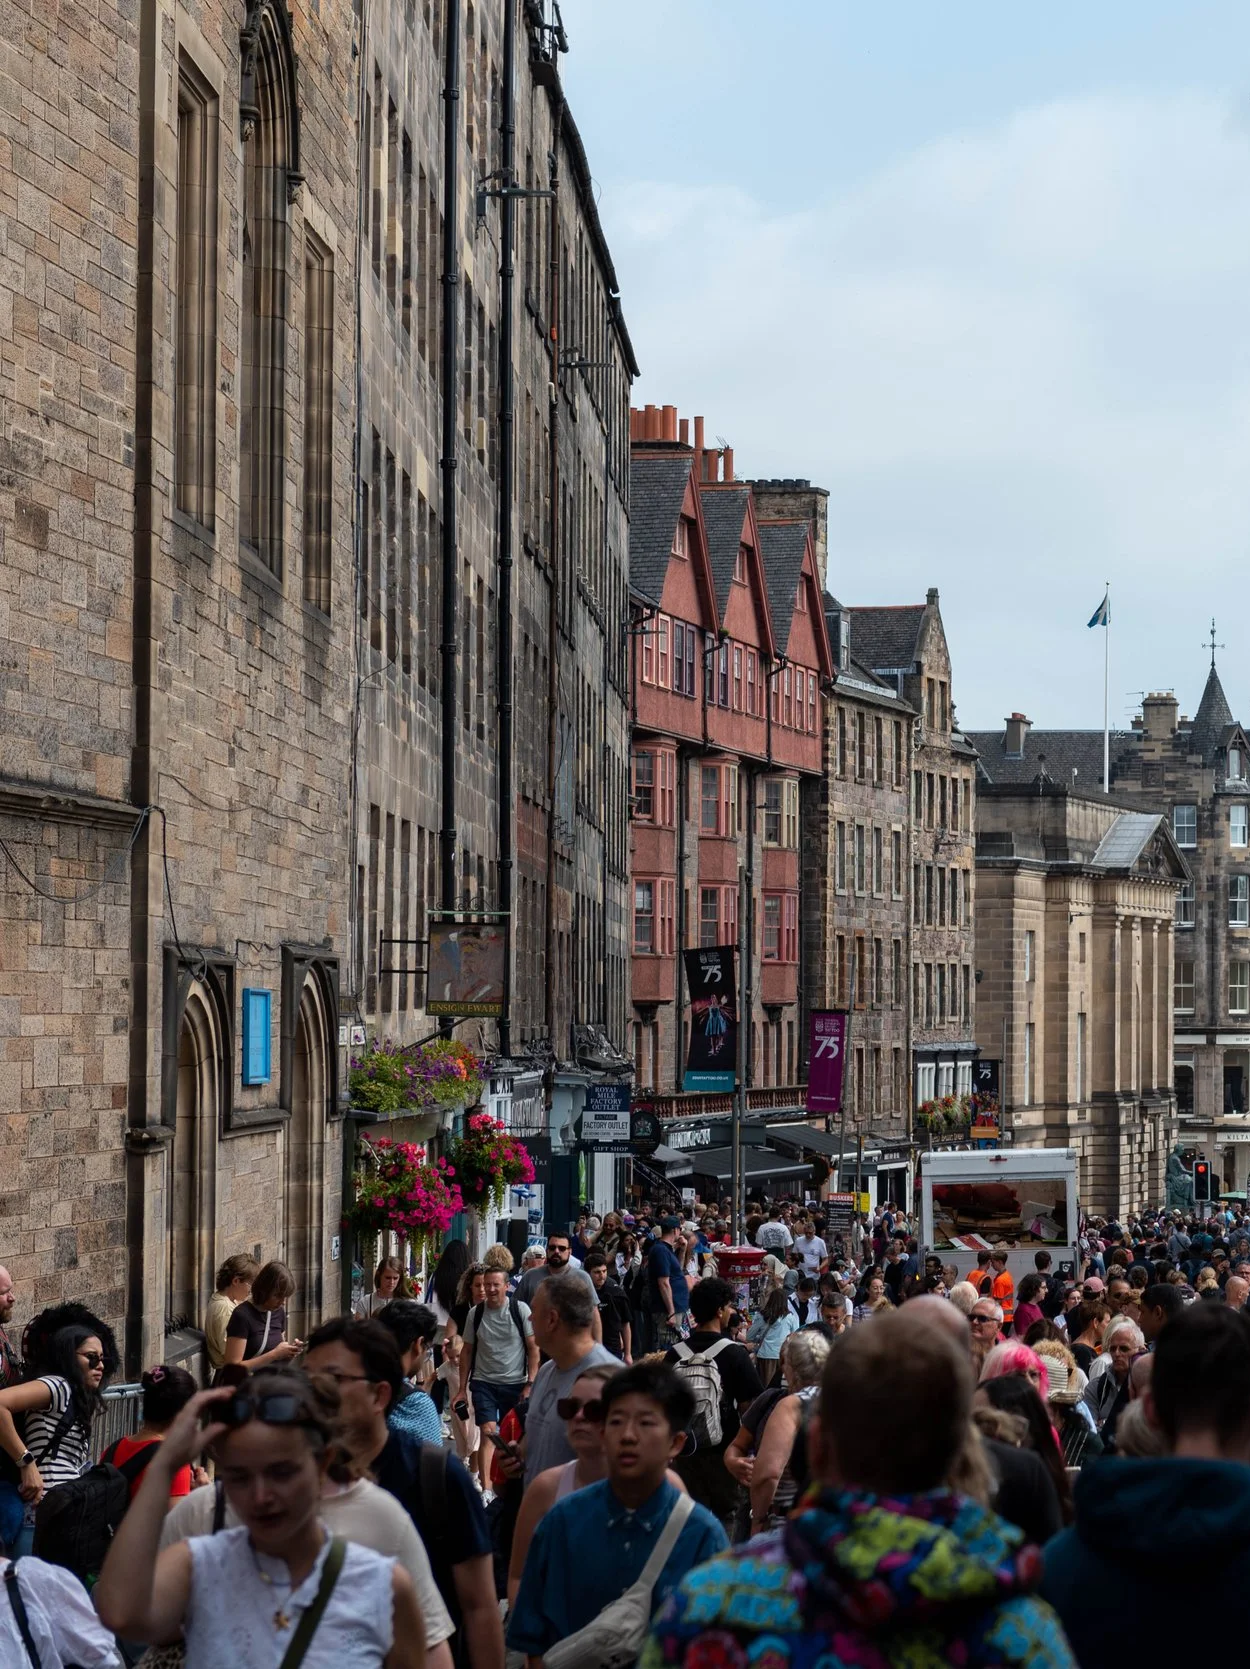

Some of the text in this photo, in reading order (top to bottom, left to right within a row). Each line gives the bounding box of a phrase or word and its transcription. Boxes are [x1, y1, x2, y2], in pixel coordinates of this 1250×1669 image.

[701, 965, 722, 983] 75
[430, 1004, 500, 1013] ENSIGN EWART
[814, 1036, 840, 1058] 75
[980, 1069, 992, 1078] 75
